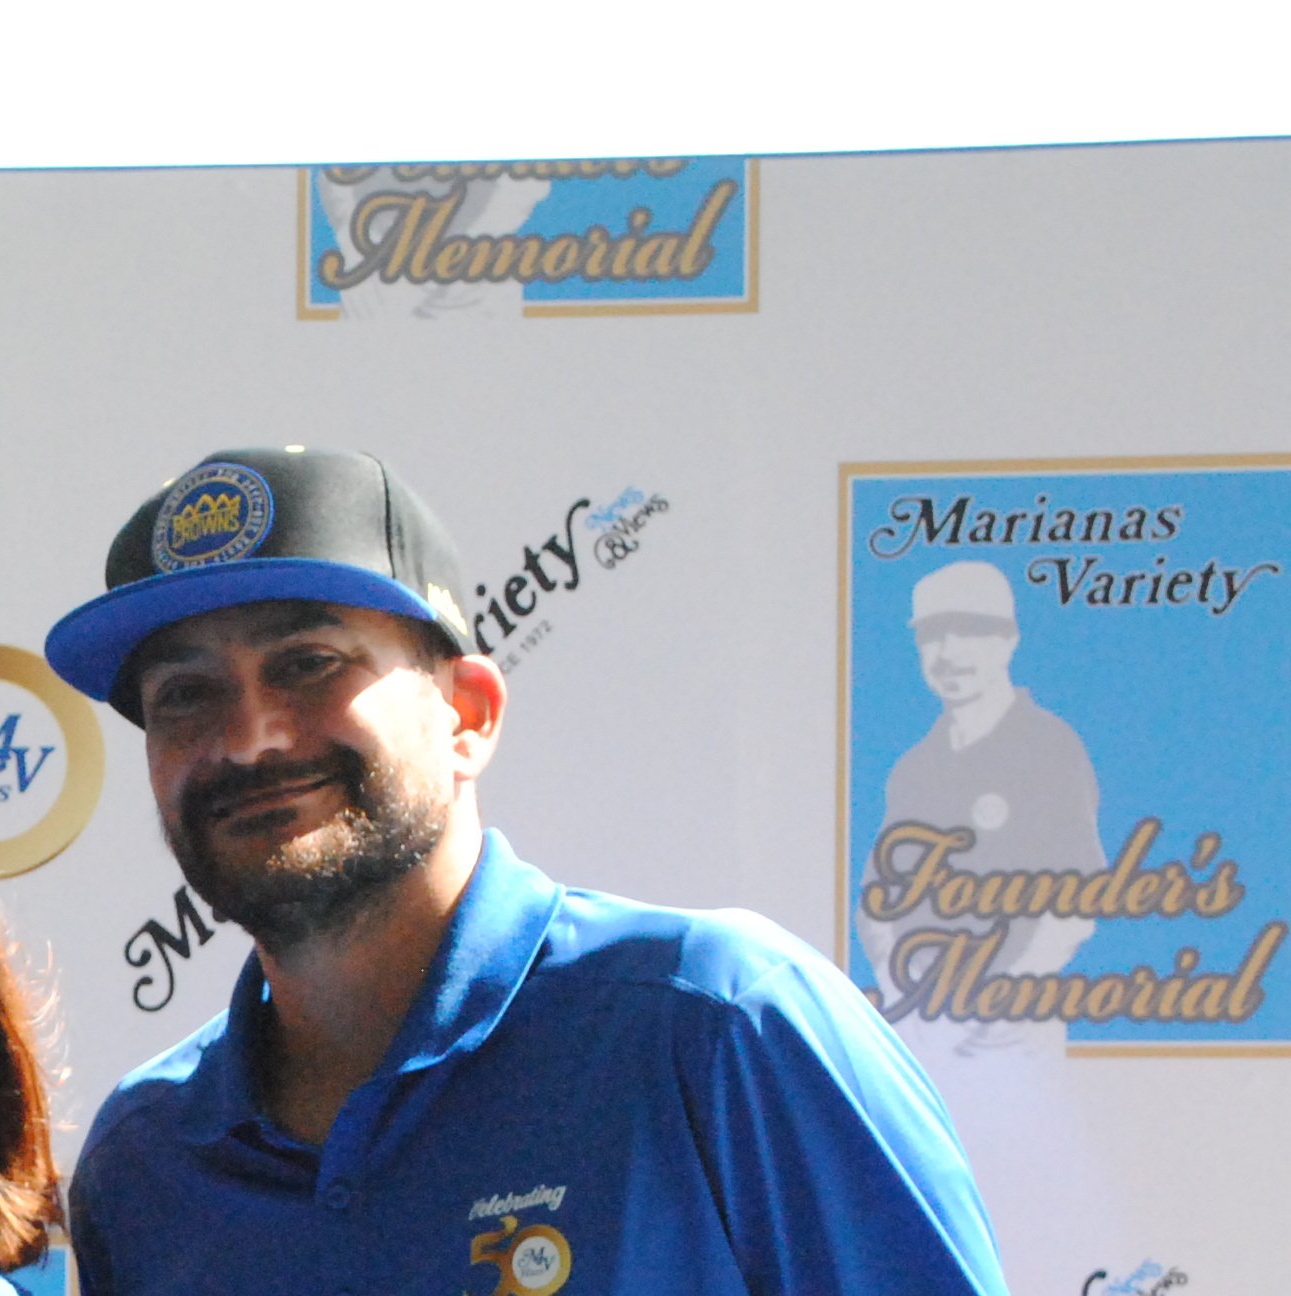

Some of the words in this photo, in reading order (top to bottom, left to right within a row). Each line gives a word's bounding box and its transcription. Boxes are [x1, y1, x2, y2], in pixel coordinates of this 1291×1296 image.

[319, 177, 738, 289] Memorial
[474, 498, 590, 656] riety
[869, 493, 1185, 559] Marianas
[1027, 556, 1281, 617] Variety
[862, 816, 1246, 921] Founder's
[863, 918, 1289, 1024] Memorial
[468, 1184, 567, 1221] Celebrating
